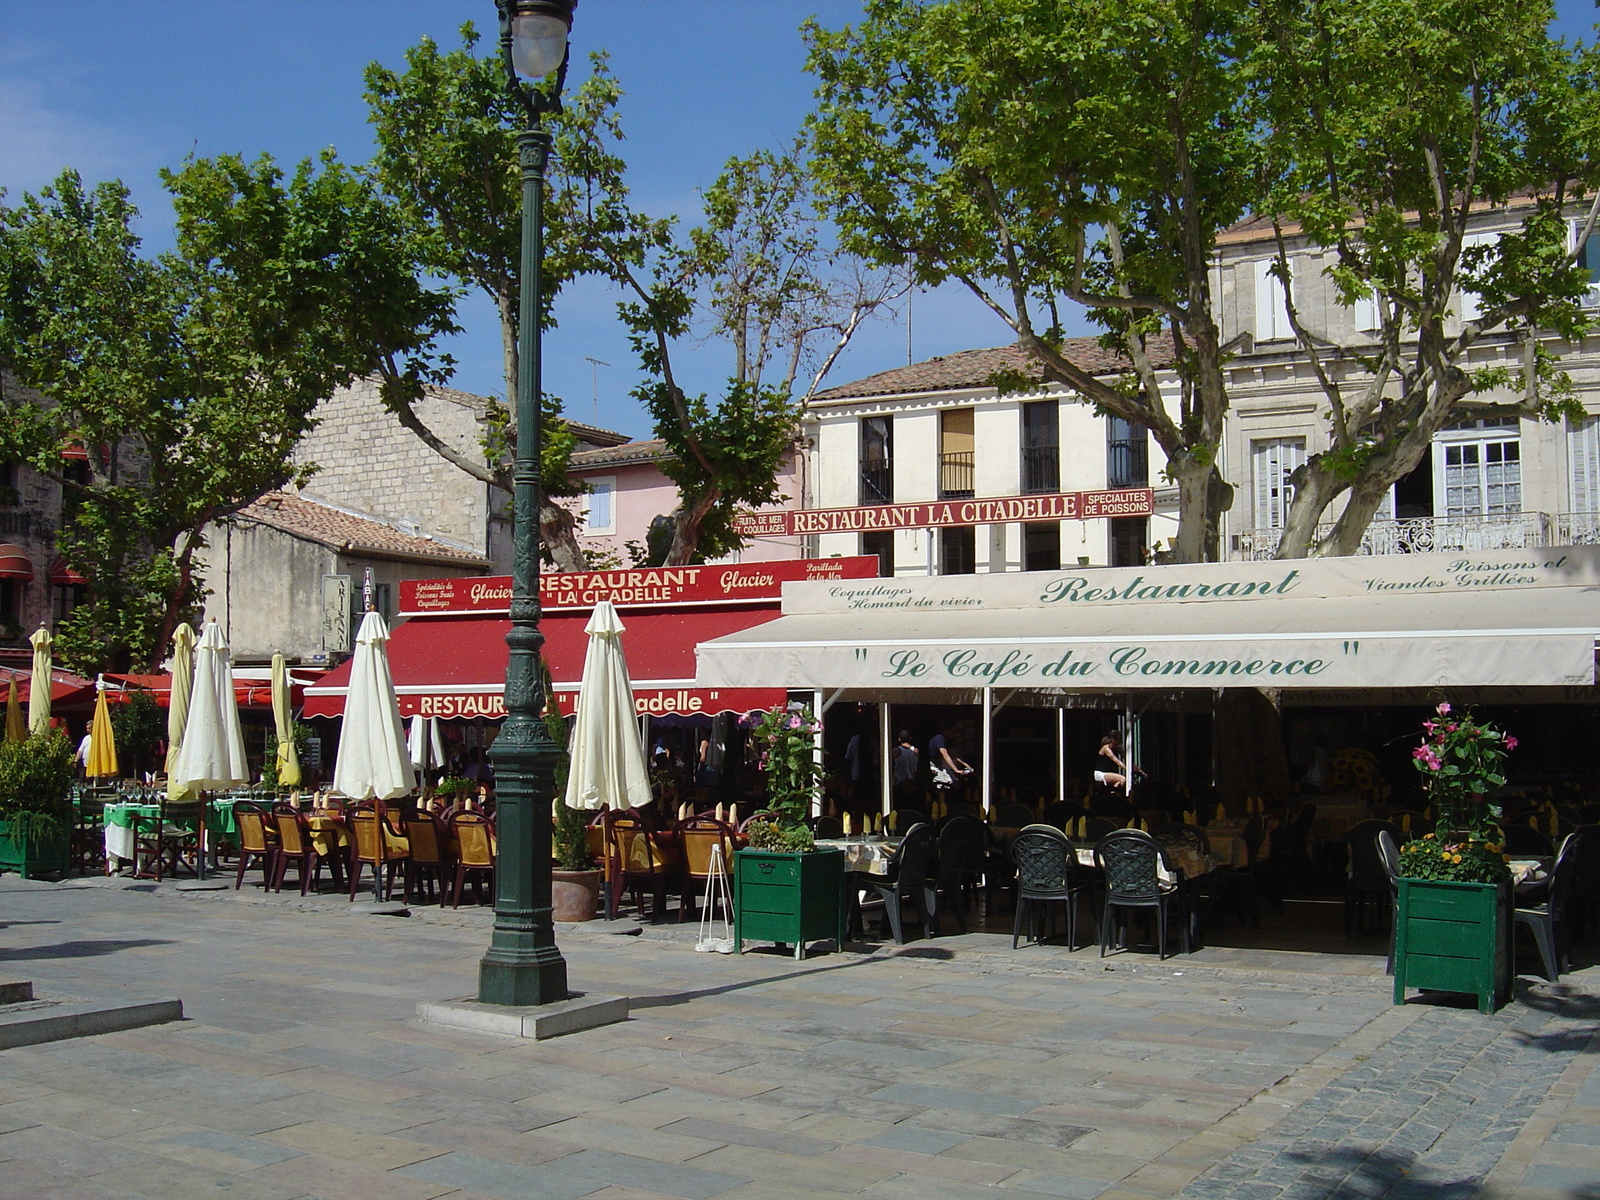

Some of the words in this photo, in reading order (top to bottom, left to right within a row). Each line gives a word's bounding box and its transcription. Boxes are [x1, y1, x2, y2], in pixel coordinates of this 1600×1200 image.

[1088, 492, 1147, 505] SPECIALITES
[793, 506, 920, 532] RESTAURANT
[927, 505, 954, 524] LA
[960, 497, 1077, 522] CITADELLE
[1085, 505, 1098, 515] DE
[1101, 502, 1149, 514] POISSONS
[743, 524, 785, 535] COQUILLAGES
[758, 516, 767, 525] DE
[769, 515, 783, 524] MER
[1446, 558, 1539, 574] Poissons
[1543, 554, 1568, 569] et
[720, 570, 774, 594] Glacier
[1040, 568, 1302, 603] Restaurant
[1361, 575, 1450, 592] Viandes
[1454, 571, 1541, 587] Grillées
[470, 583, 514, 605] Glacier
[557, 591, 577, 605] LA
[582, 587, 671, 604] CITADELLE
[829, 585, 915, 600] Coquillages
[848, 598, 913, 610] Homard
[914, 596, 934, 608] du
[939, 597, 985, 607] vivier
[881, 649, 934, 678] Le
[942, 649, 1038, 684] Café
[1041, 649, 1102, 677] du
[1109, 646, 1334, 676] Commerce
